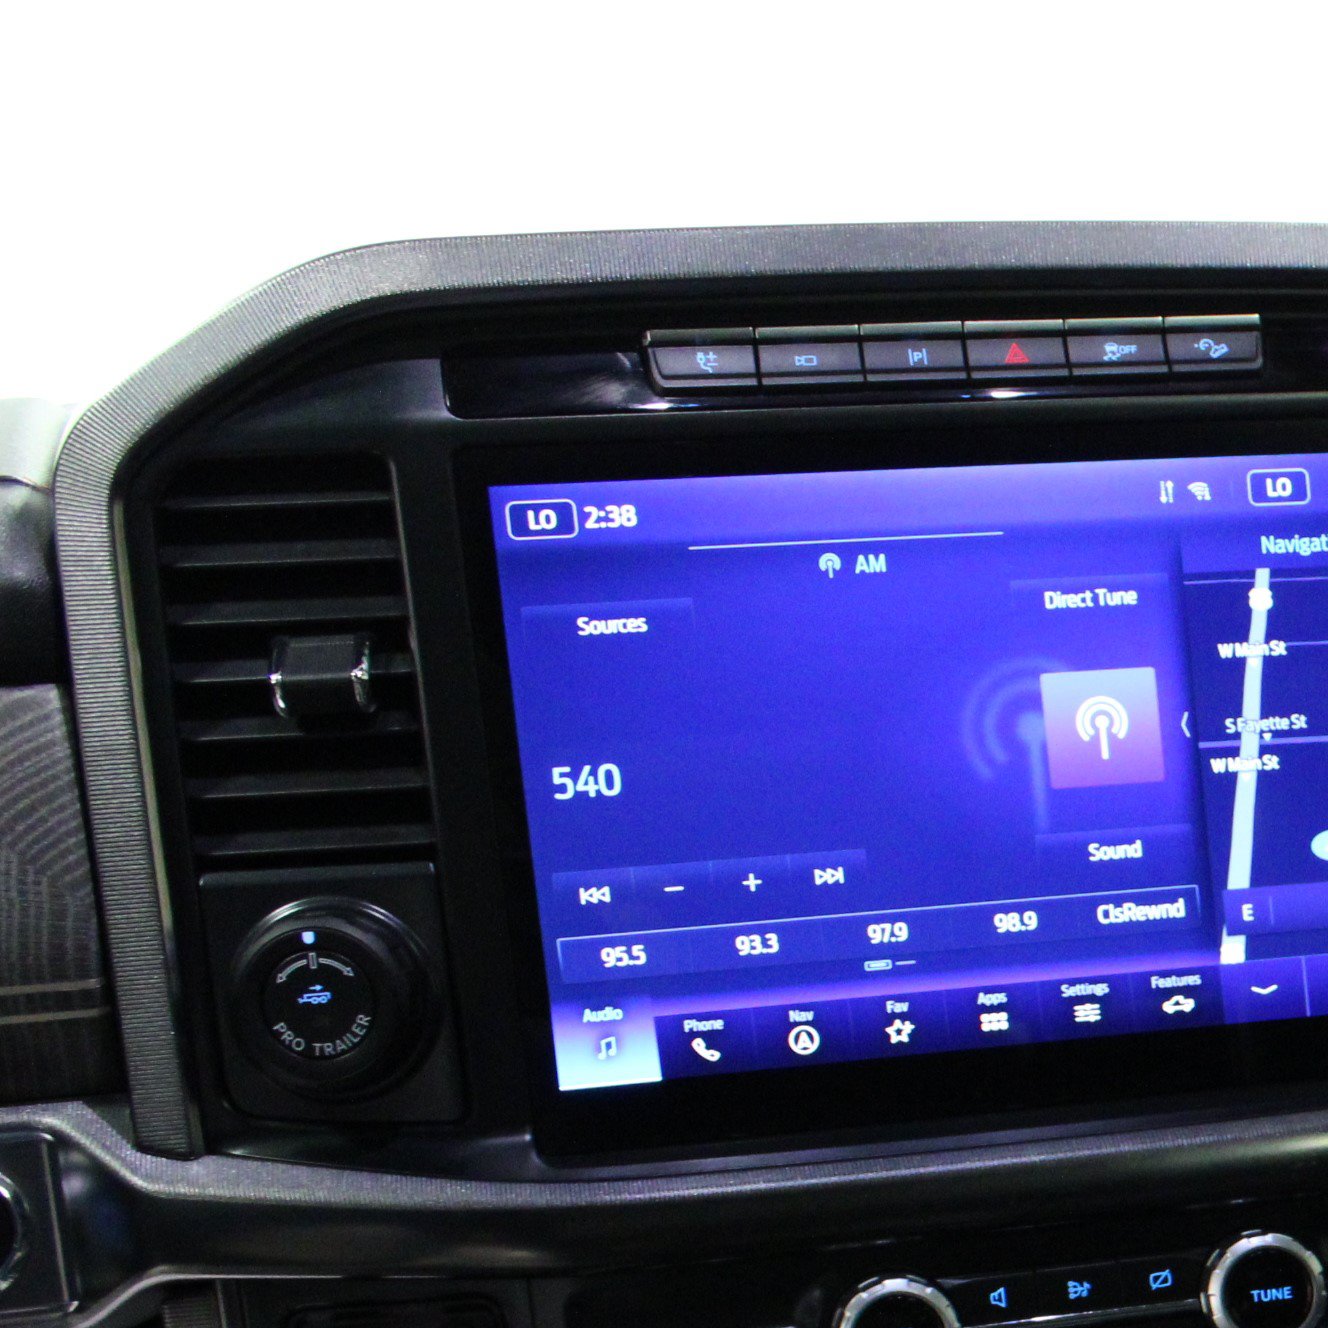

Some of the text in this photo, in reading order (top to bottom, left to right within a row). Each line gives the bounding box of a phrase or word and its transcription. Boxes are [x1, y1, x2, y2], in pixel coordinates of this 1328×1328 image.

[1119, 344, 1138, 355] OFF
[1265, 477, 1293, 498] LO
[526, 509, 558, 531] LO
[583, 504, 638, 529] 2:38
[854, 553, 887, 574] AM
[1043, 588, 1139, 610] Direct Tune
[576, 615, 648, 636] Sources
[1217, 639, 1288, 659] W Main St
[1224, 713, 1308, 734] S Fayette St
[1210, 753, 1280, 774] W Main St
[551, 762, 623, 801] 540
[1088, 839, 1143, 862] Sound
[993, 910, 1038, 933] 98.9
[1096, 898, 1186, 925] ClsRewnd
[1242, 903, 1254, 922] E
[866, 921, 909, 945] 97.9
[735, 933, 780, 957] 93.3
[600, 944, 648, 968] 95.5
[1060, 980, 1110, 999] Settings
[1150, 972, 1202, 989] Features
[885, 1000, 910, 1015] Fav
[977, 990, 1008, 1007] Apps
[582, 1006, 624, 1024] Audio
[683, 1017, 725, 1034] Phone
[789, 1009, 814, 1023] Nav
[272, 1013, 373, 1057] PRO TRAILER
[1250, 1285, 1294, 1303] TUNE
